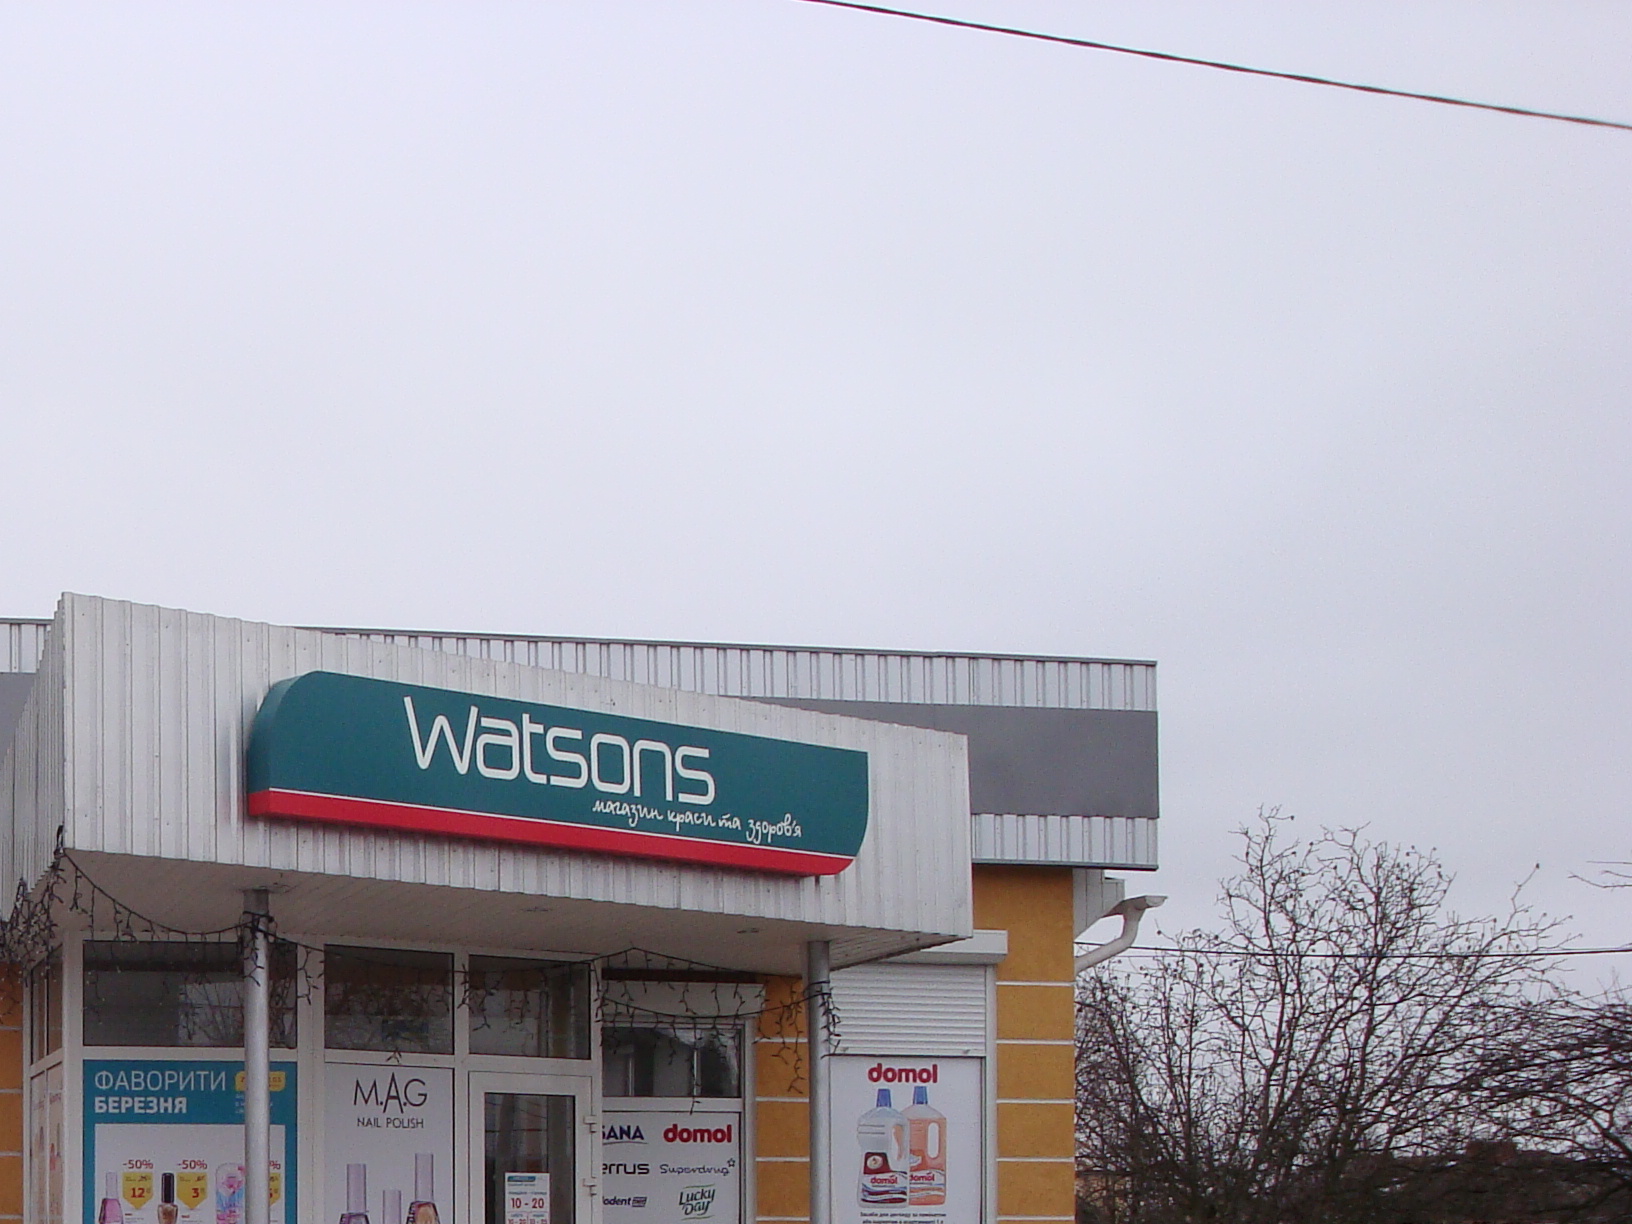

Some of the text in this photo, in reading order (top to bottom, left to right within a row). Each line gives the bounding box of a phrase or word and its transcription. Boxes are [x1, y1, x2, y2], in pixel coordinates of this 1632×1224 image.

[403, 696, 716, 805] Watsons
[592, 800, 664, 828] магазин
[667, 809, 716, 832] краси
[718, 813, 742, 830] та
[867, 1062, 938, 1084] domol
[94, 1070, 226, 1092] ФАВОРИТИ
[94, 1096, 187, 1114] БЕРЕЗНЯ
[356, 1117, 424, 1129] NAIL POLISH
[602, 1125, 644, 1140] ANA
[663, 1123, 732, 1143] domol
[122, 1160, 153, 1170] -50%
[177, 1160, 208, 1170] -50%
[659, 1163, 731, 1177] Superdrug
[870, 1175, 898, 1184] domol
[131, 1187, 145, 1198] 12
[679, 1188, 716, 1206] Lucky
[511, 1197, 522, 1209] 10
[531, 1197, 545, 1209] 20
[683, 1201, 710, 1216] Day
